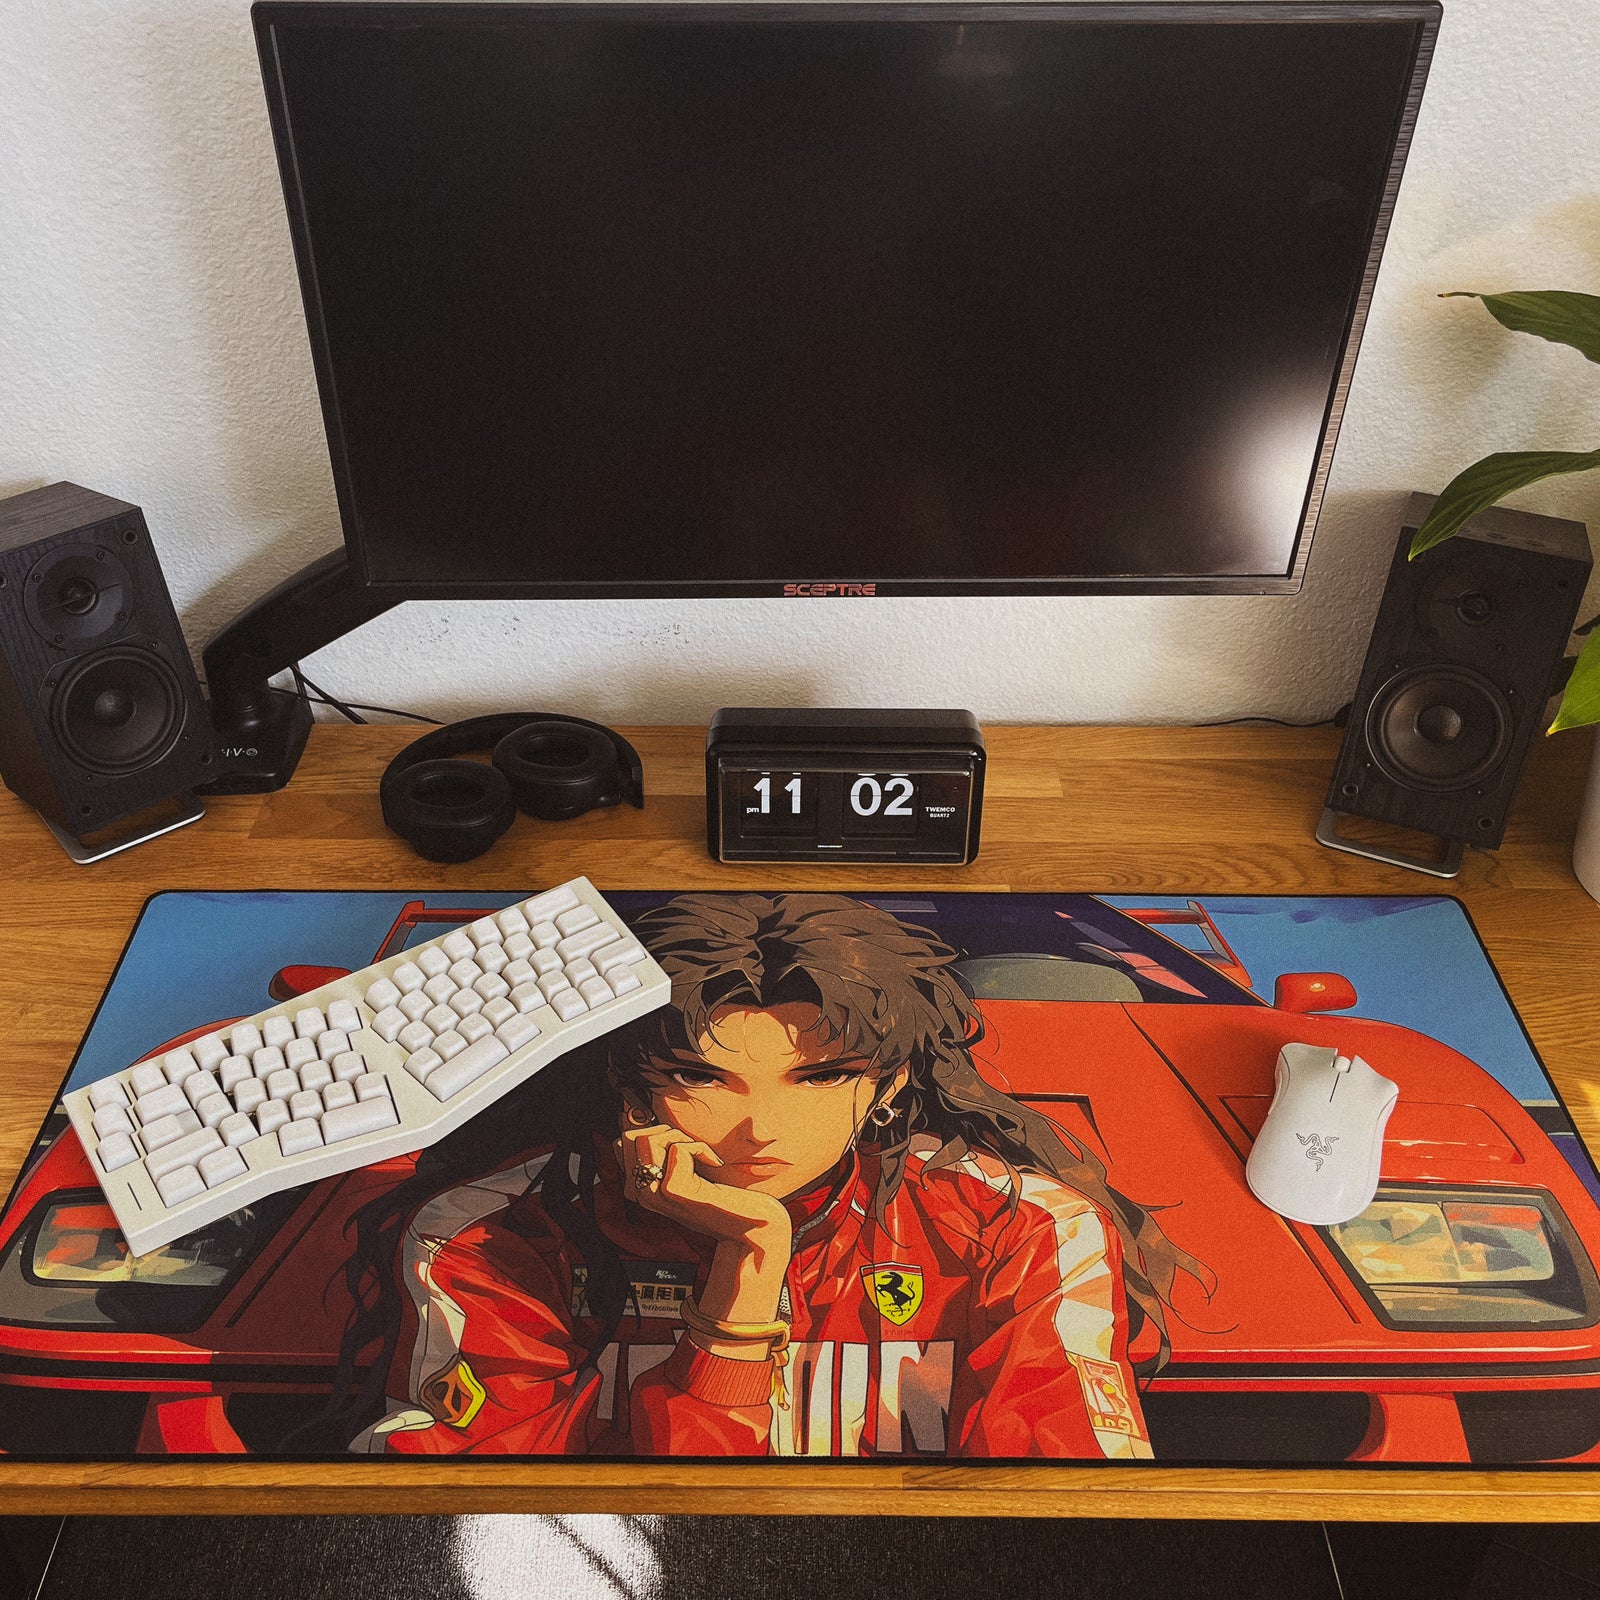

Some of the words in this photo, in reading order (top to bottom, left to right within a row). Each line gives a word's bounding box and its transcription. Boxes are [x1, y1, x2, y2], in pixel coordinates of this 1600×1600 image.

[783, 583, 876, 597] SCEPTRE
[753, 777, 802, 814] 11
[850, 777, 914, 817] 02
